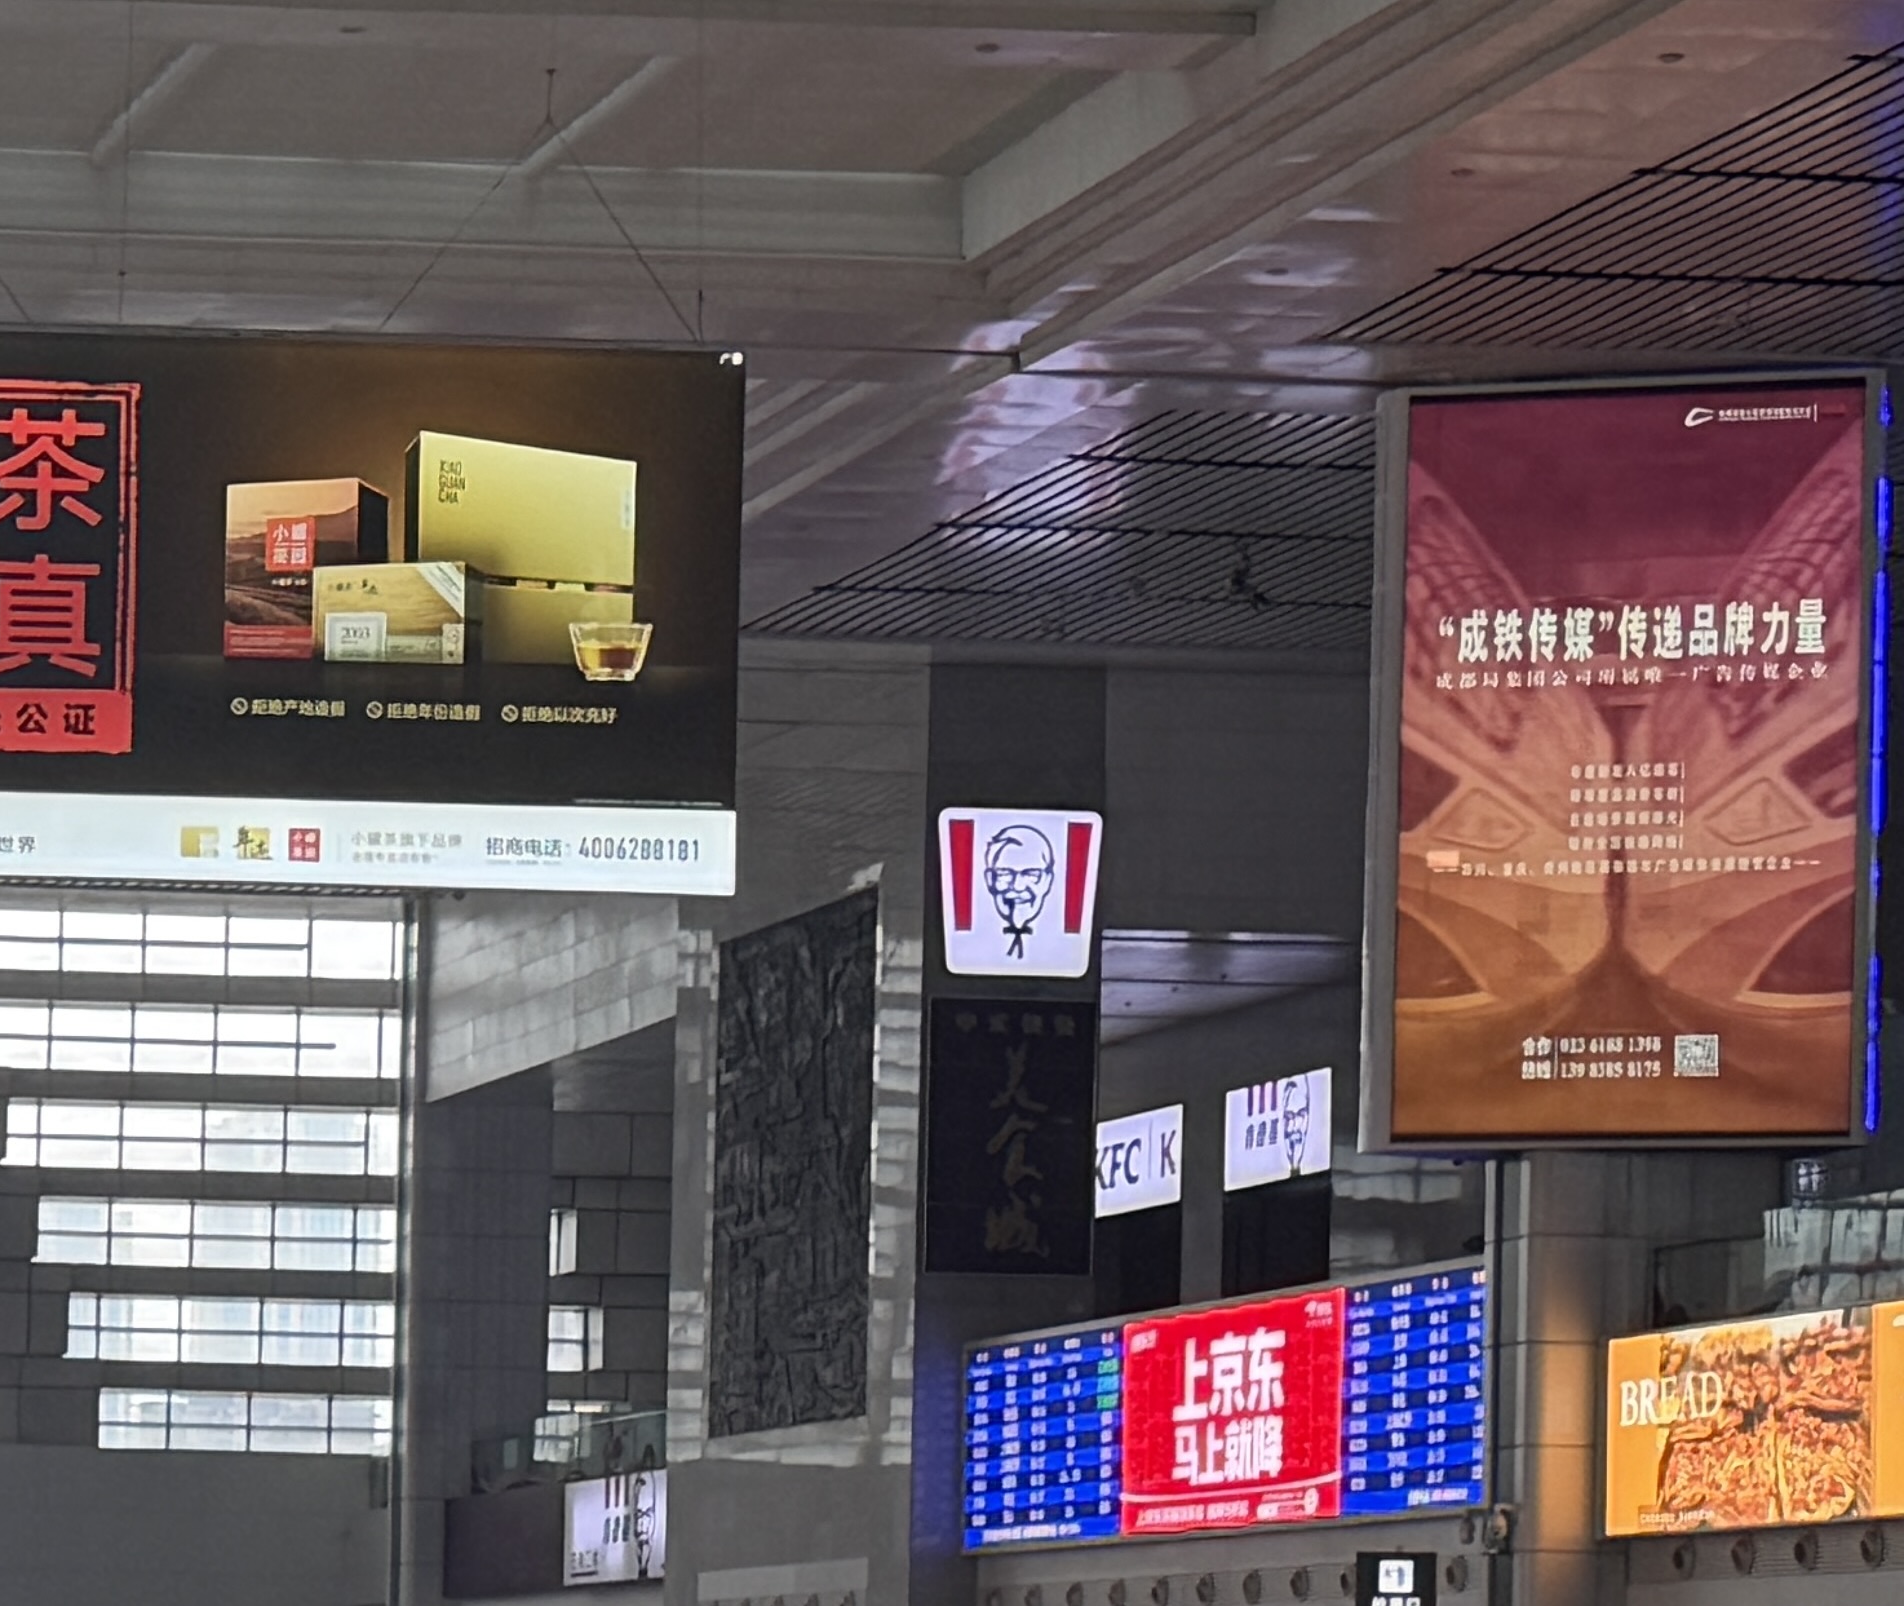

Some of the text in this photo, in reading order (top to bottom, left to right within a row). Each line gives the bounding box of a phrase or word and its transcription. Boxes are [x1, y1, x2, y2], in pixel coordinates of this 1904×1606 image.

[1438, 597, 1828, 664] “成铁传媒”传递品牌力量
[1171, 1326, 1286, 1422] 上京东
[1618, 1371, 1724, 1428] BREAD
[1171, 1414, 1284, 1487] 马上就降
